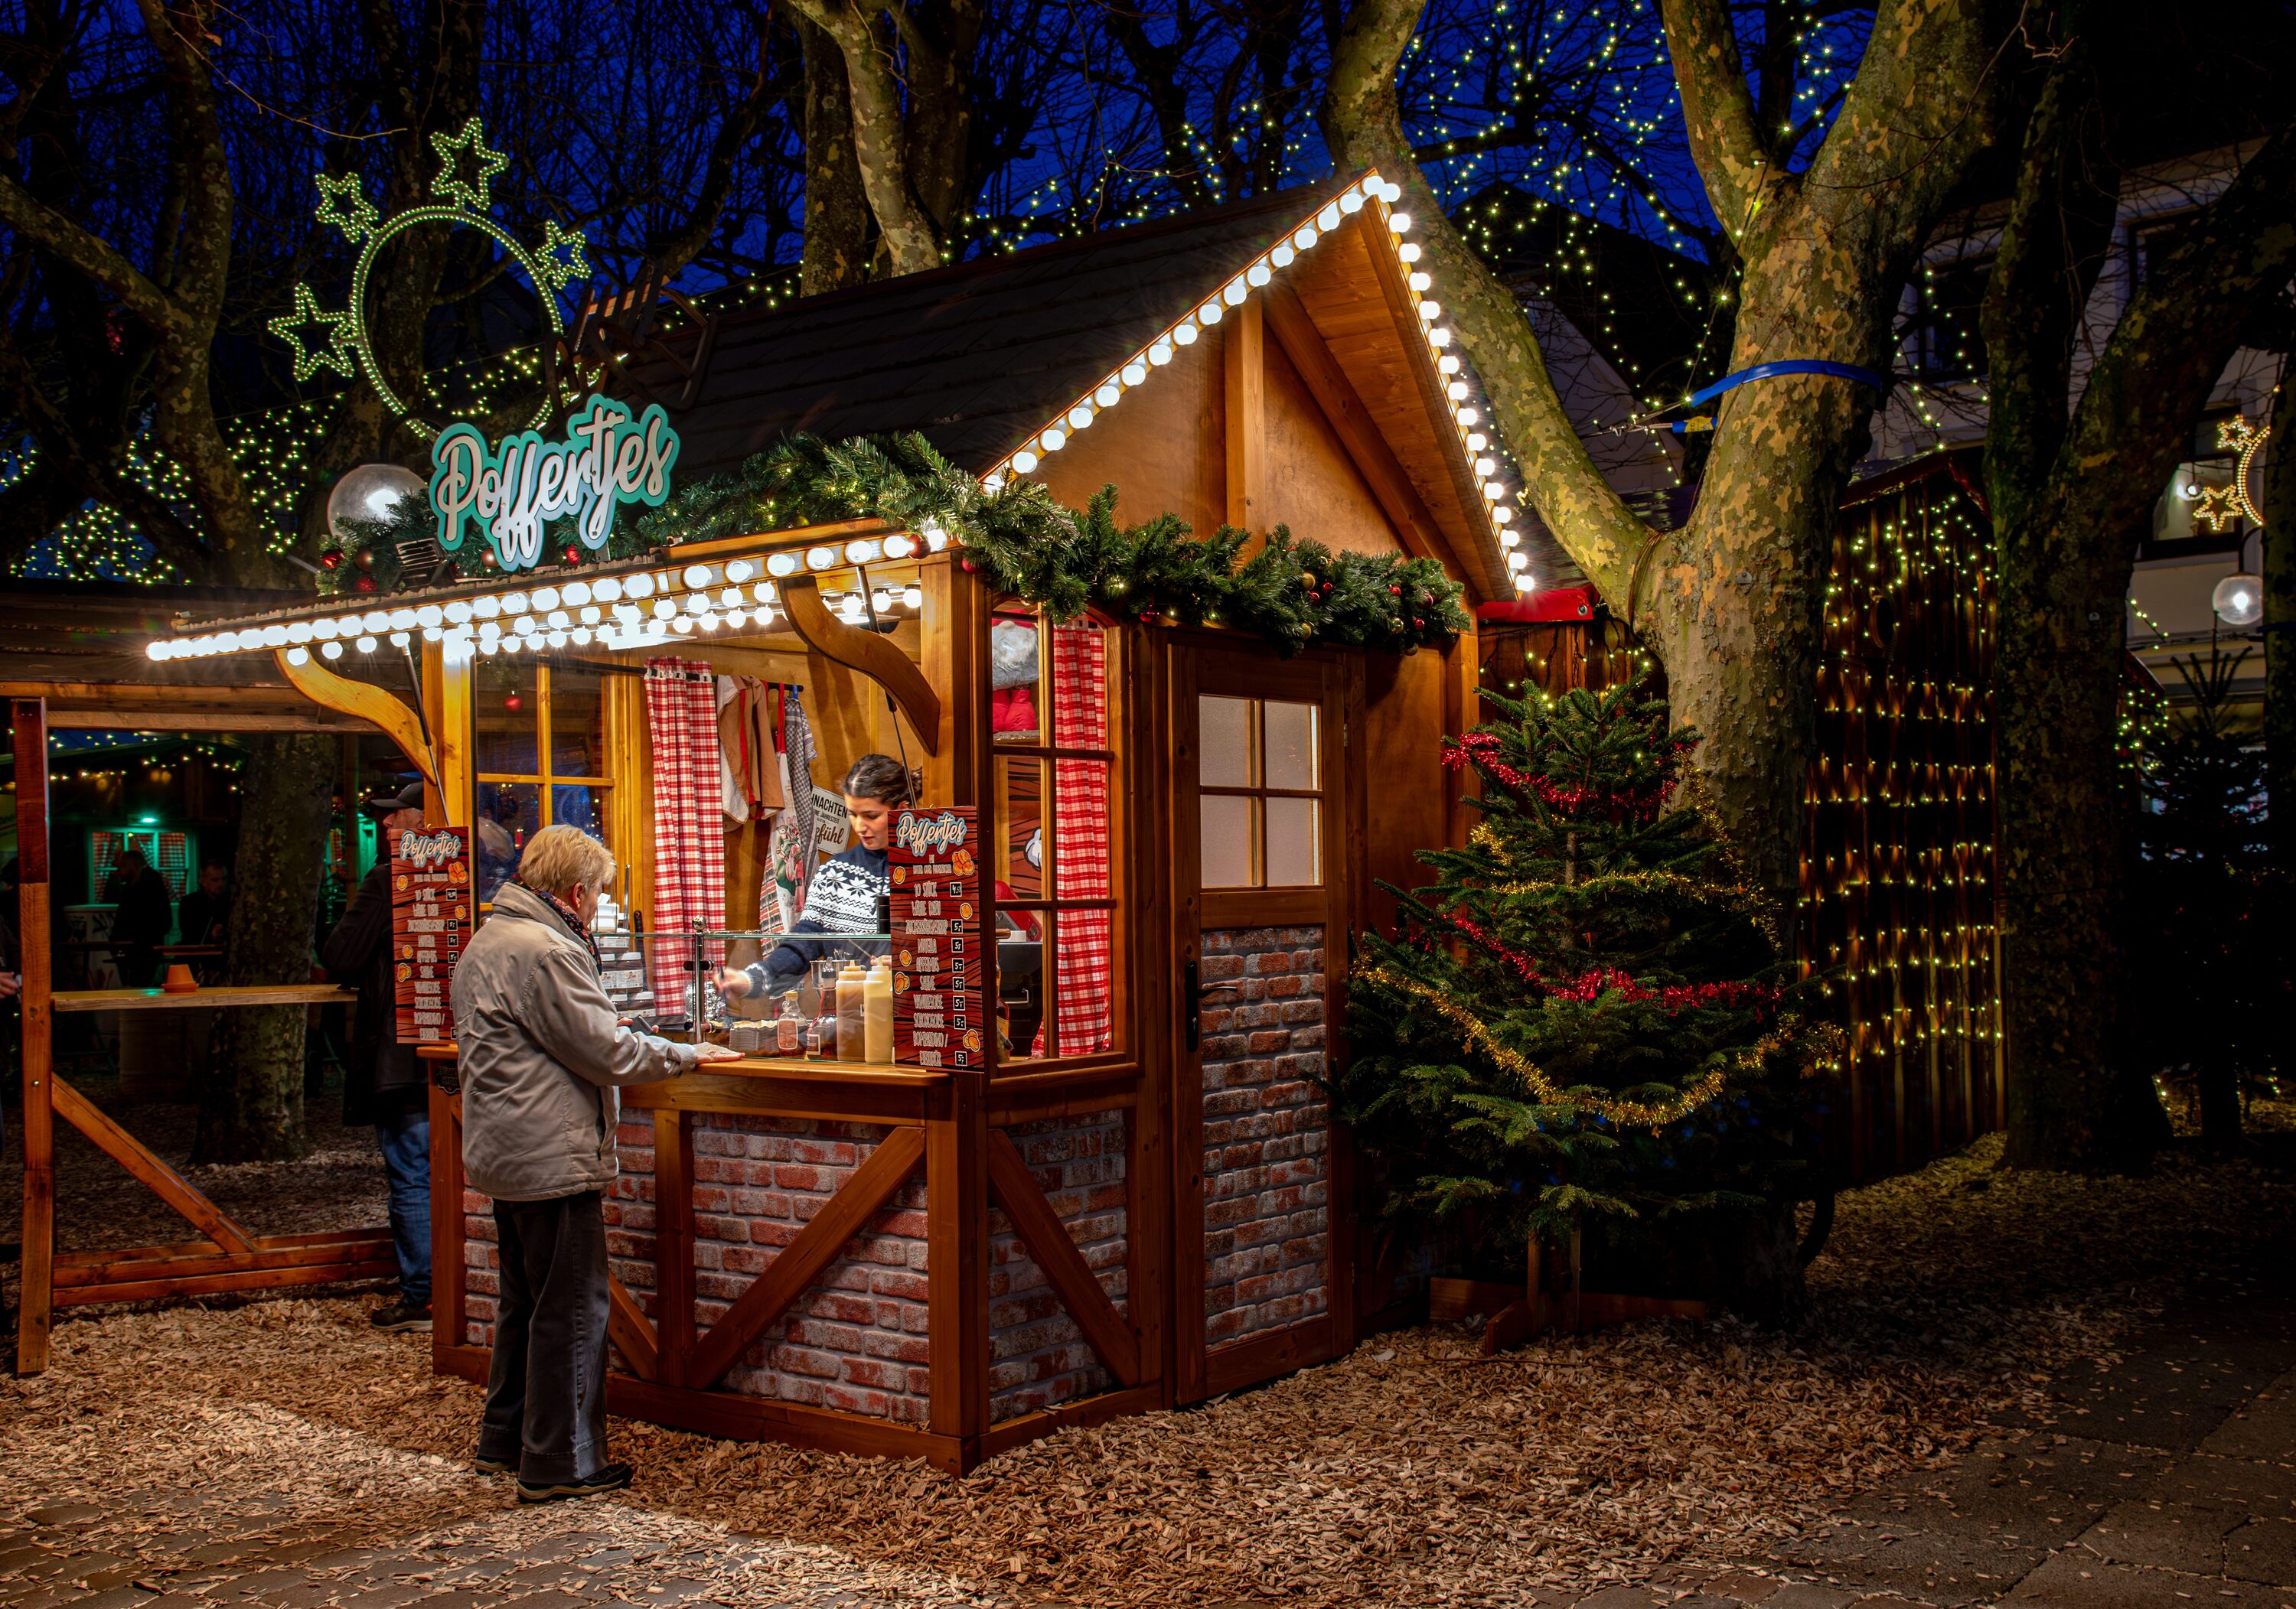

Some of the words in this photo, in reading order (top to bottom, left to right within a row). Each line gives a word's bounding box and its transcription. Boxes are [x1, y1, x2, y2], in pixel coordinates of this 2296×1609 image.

[435, 406, 674, 563] Poffertjes
[401, 832, 460, 865] Poffertjes
[898, 814, 965, 855] Poffertjes
